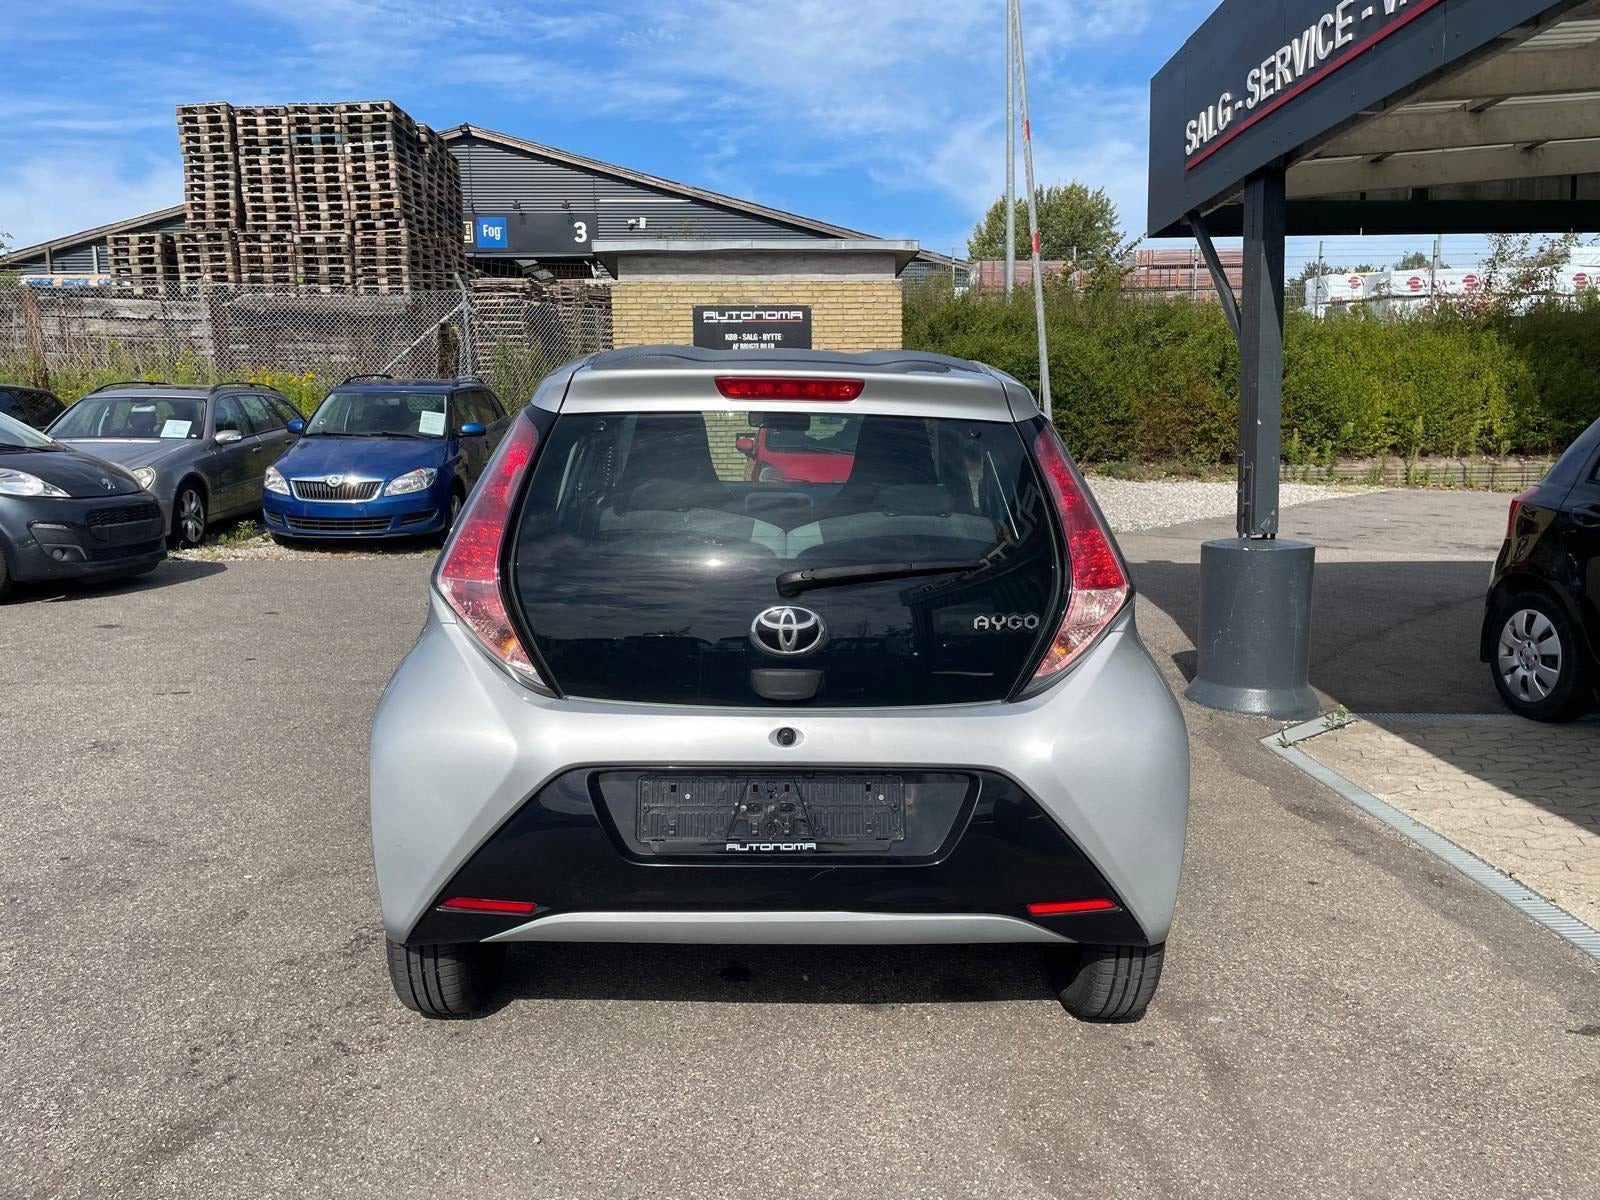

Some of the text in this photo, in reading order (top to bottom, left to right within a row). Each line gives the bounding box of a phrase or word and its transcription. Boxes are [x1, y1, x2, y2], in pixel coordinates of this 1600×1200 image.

[1185, 92, 1231, 155] SALG
[1246, 0, 1353, 109] SERVICE
[482, 224, 502, 241] Fog
[573, 221, 588, 243] 3
[703, 311, 803, 320] AUTONOMA
[742, 333, 759, 341] SALG
[762, 333, 783, 341] BYTTE
[973, 614, 1040, 631] AYGO
[726, 842, 816, 851] AUTONOMA
